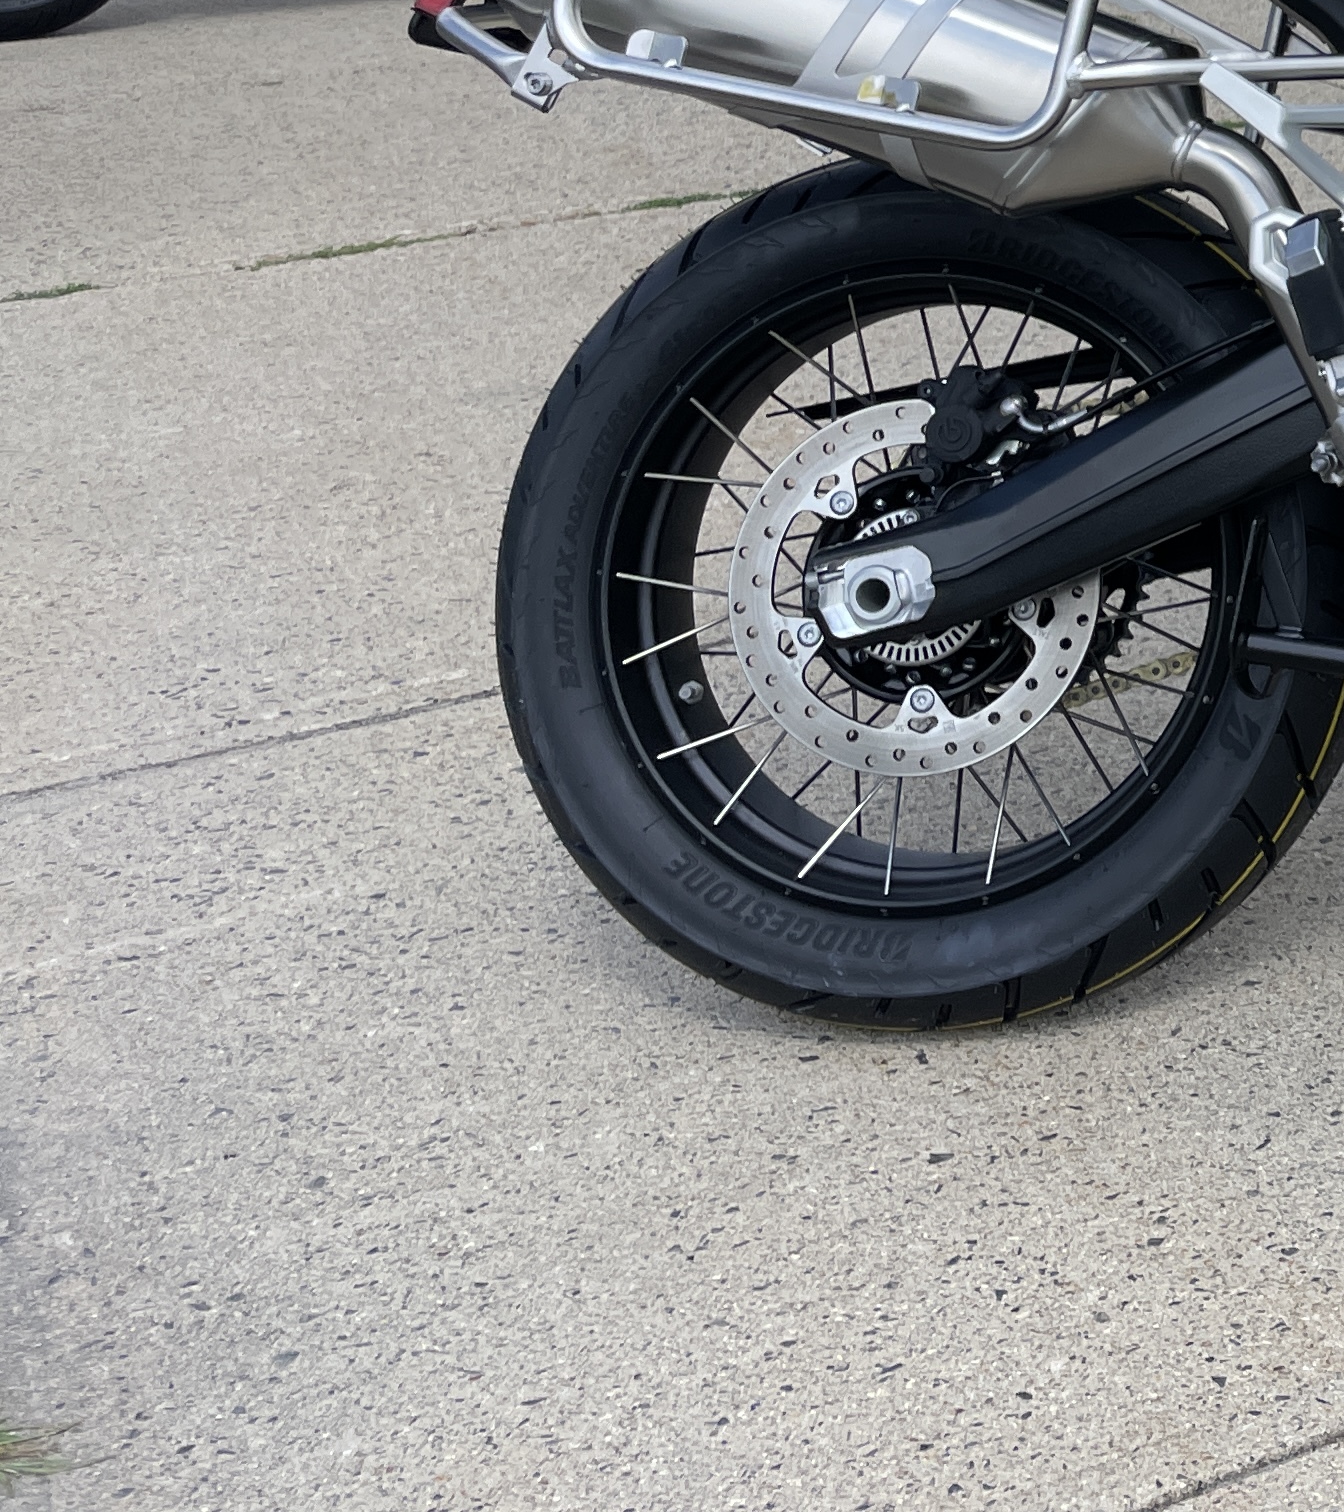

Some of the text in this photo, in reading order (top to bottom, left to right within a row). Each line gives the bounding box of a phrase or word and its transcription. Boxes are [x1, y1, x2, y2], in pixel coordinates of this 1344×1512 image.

[553, 391, 634, 690] BATTLAX ADVENTURE
[661, 849, 915, 965] BRIDGESTONE
